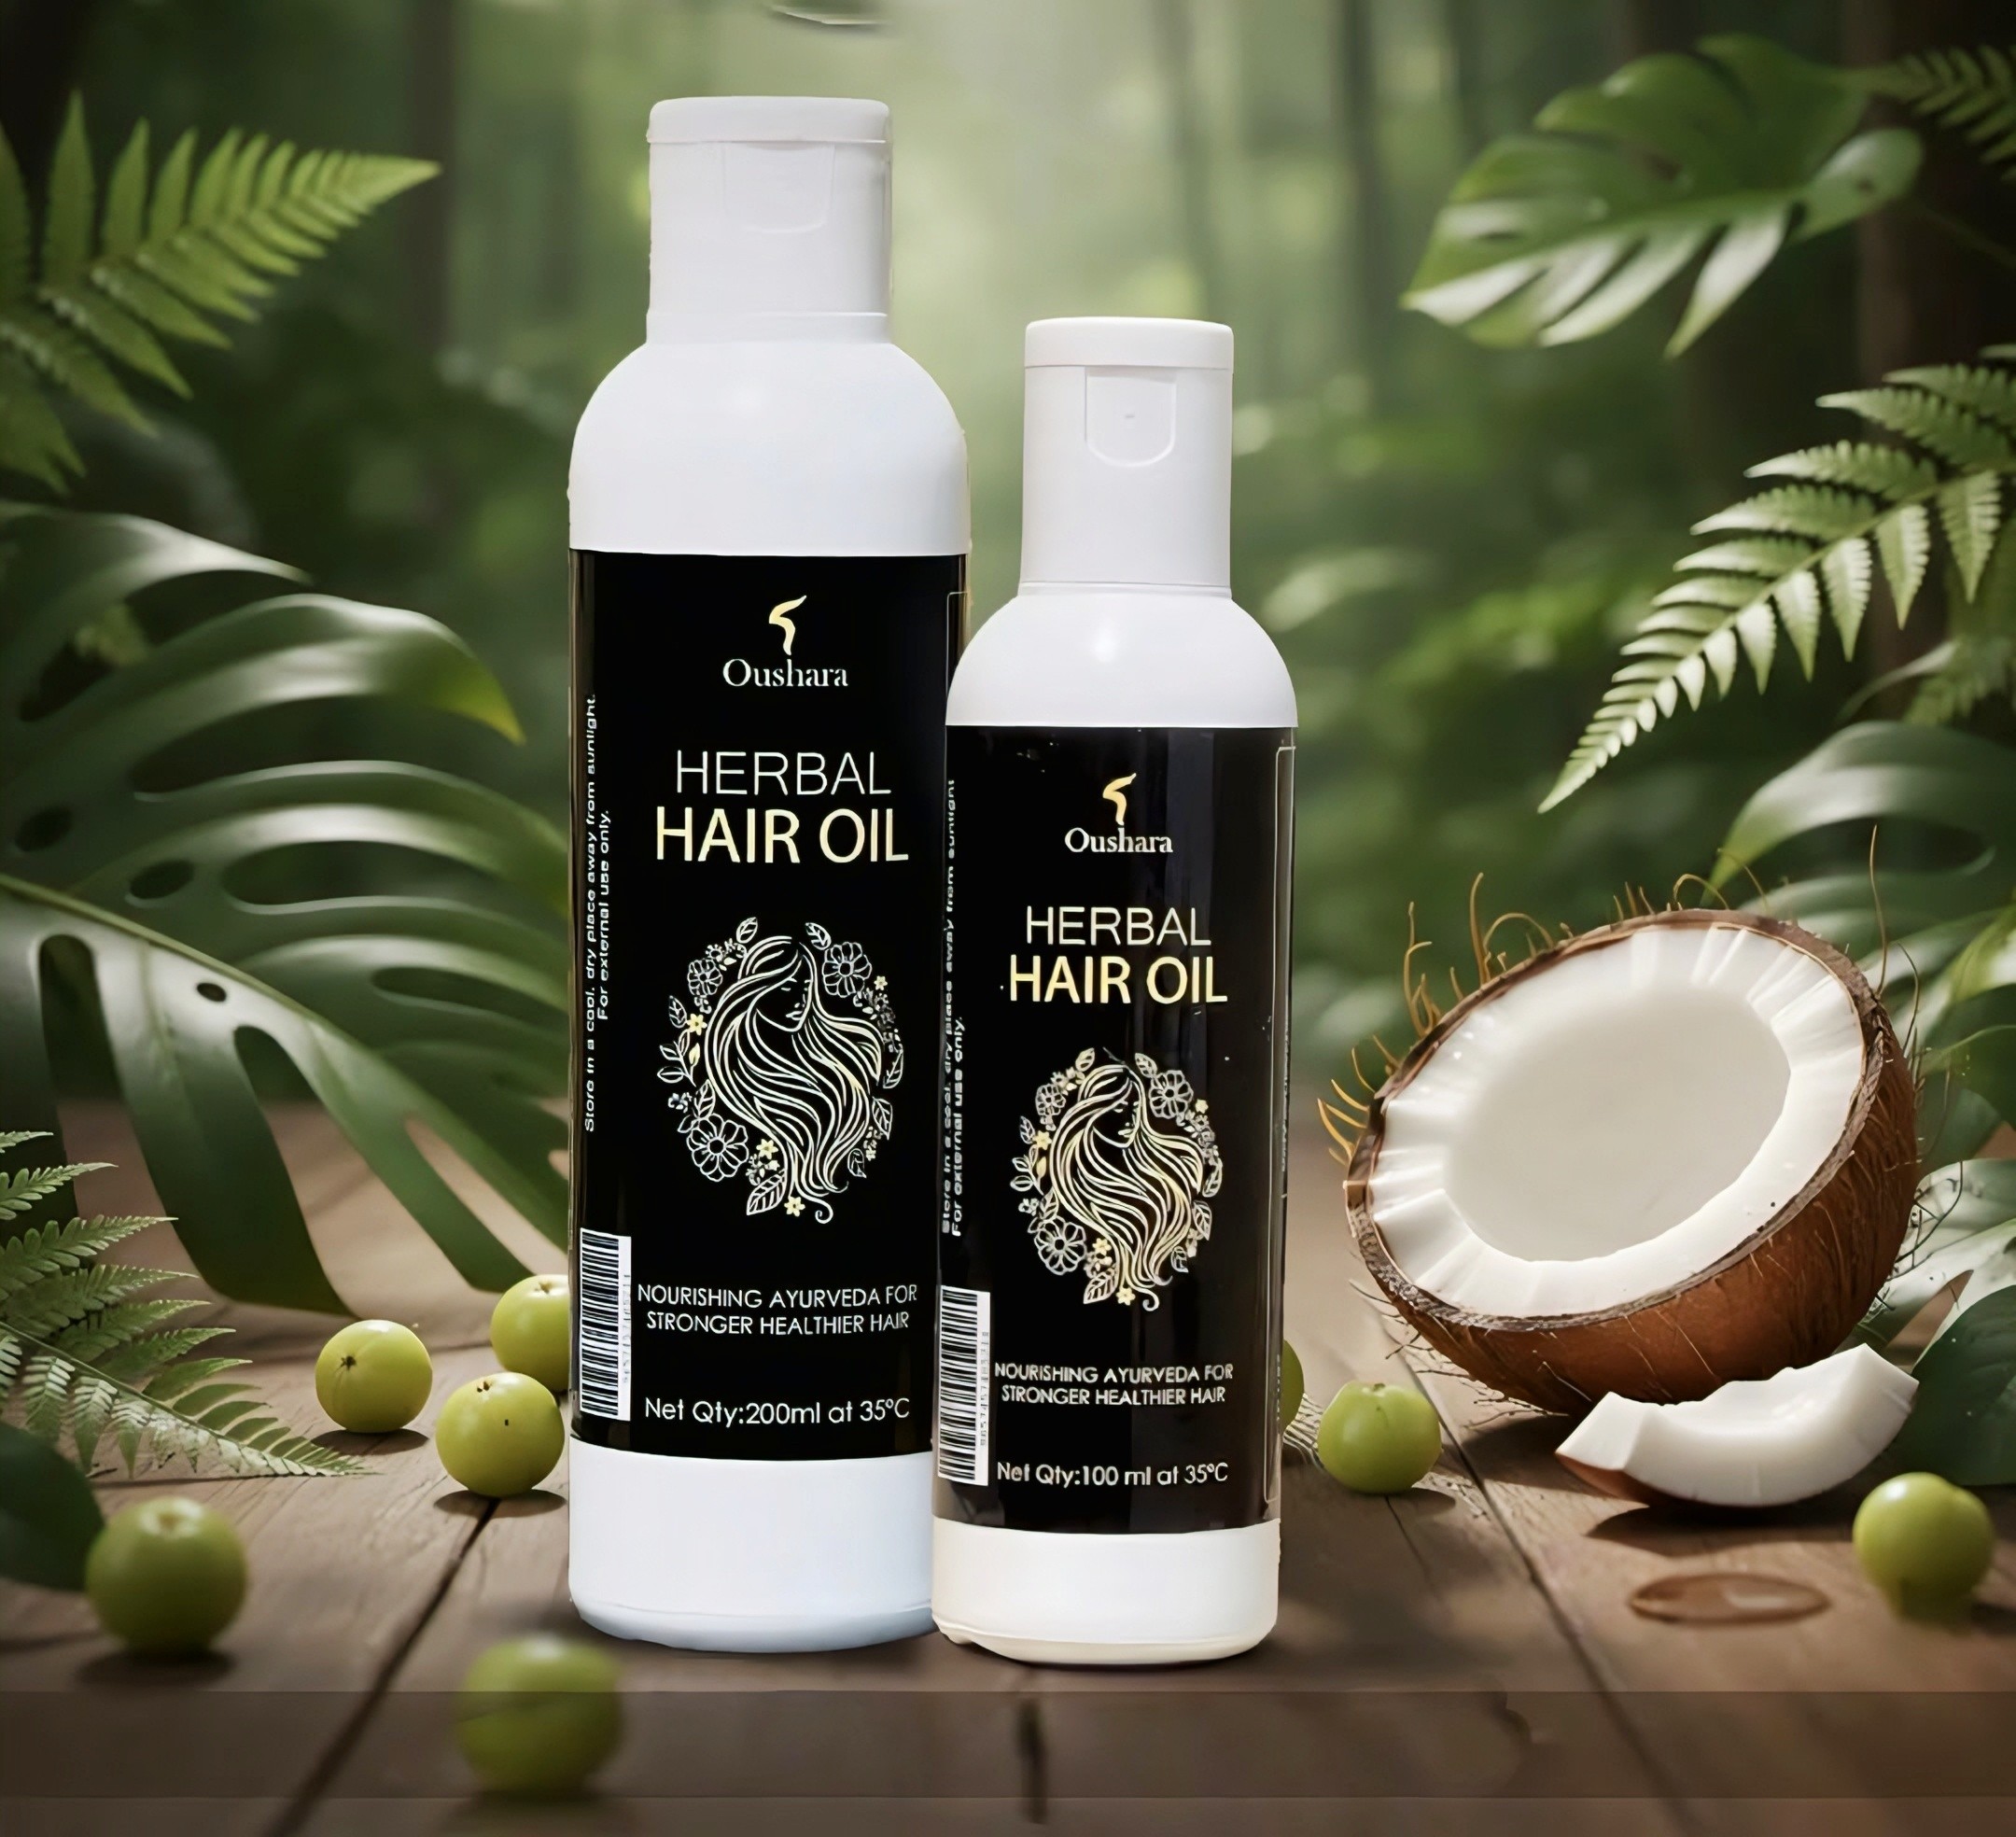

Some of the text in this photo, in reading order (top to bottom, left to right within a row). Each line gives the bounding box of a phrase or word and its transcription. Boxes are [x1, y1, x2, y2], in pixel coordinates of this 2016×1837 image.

[723, 659, 847, 686] Oushara
[678, 750, 891, 795] HERBAL
[586, 782, 595, 824] from
[656, 806, 909, 863] HAIR OIL
[1064, 826, 1173, 853] Oushara
[587, 832, 597, 883] away
[586, 890, 596, 942] place
[597, 810, 610, 1019] For external use only.
[1027, 905, 1211, 946] HERBAL
[586, 948, 596, 978] dry
[1010, 954, 1228, 1004] HAIR OIL
[952, 1201, 962, 1236] For
[638, 1284, 917, 1308] NOURISHING AYURVEDA FOR
[647, 1311, 909, 1335] STRONGER HEALTHIER HAIR
[995, 1363, 1233, 1384] NOURISHING AYURVEDA FOR
[1001, 1385, 1225, 1406] STRONGER HEALTHIER HAIR
[645, 1397, 684, 1420] Net
[693, 1400, 820, 1428] Qty:200ml
[829, 1401, 853, 1423] at
[997, 1462, 1030, 1482] Net
[1036, 1465, 1119, 1489] Qty:100
[1125, 1466, 1151, 1486] ml
[1157, 1465, 1179, 1485] at
